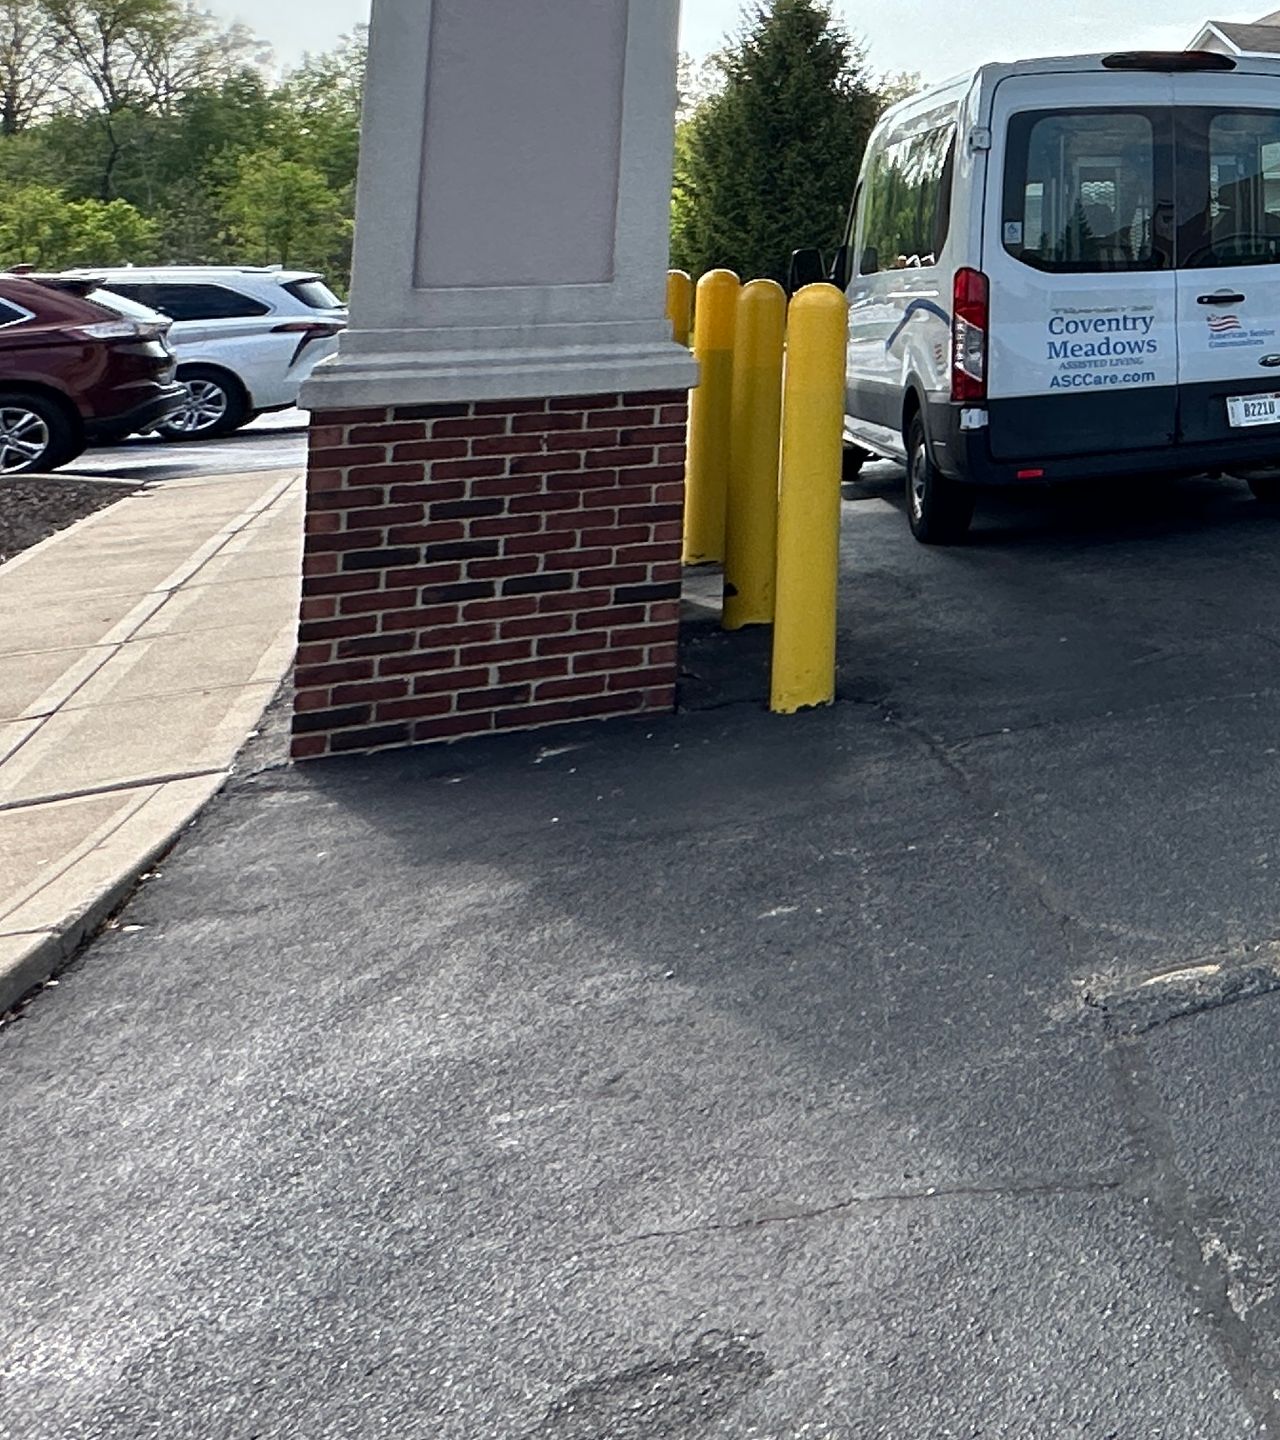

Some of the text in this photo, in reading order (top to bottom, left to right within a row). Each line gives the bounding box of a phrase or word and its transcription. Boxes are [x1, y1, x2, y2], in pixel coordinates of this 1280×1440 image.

[1048, 314, 1155, 335] Coventry
[1047, 336, 1157, 360] Meadows
[1050, 372, 1155, 388] ASCCare.com
